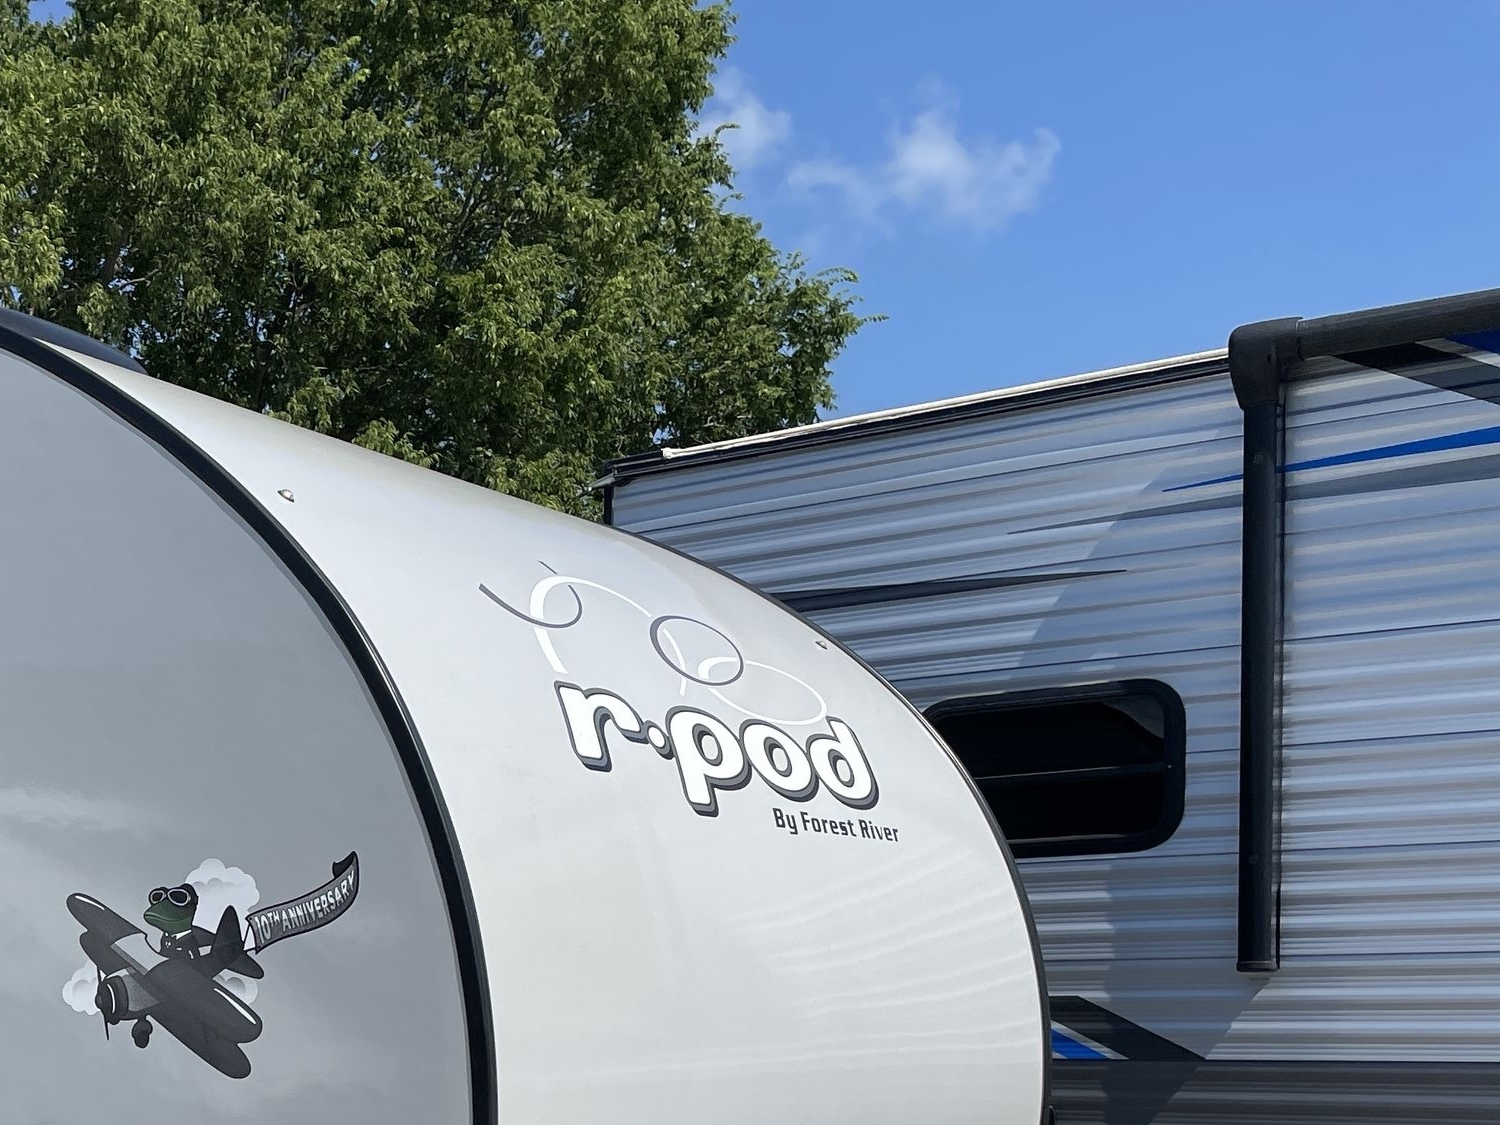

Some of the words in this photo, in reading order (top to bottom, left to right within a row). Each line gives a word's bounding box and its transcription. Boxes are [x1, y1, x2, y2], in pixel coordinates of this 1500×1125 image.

[772, 807, 799, 835] By
[799, 811, 858, 837] Forest
[857, 819, 899, 842] River
[254, 910, 281, 944] 10TH
[281, 869, 355, 932] ANNIVERSARY
